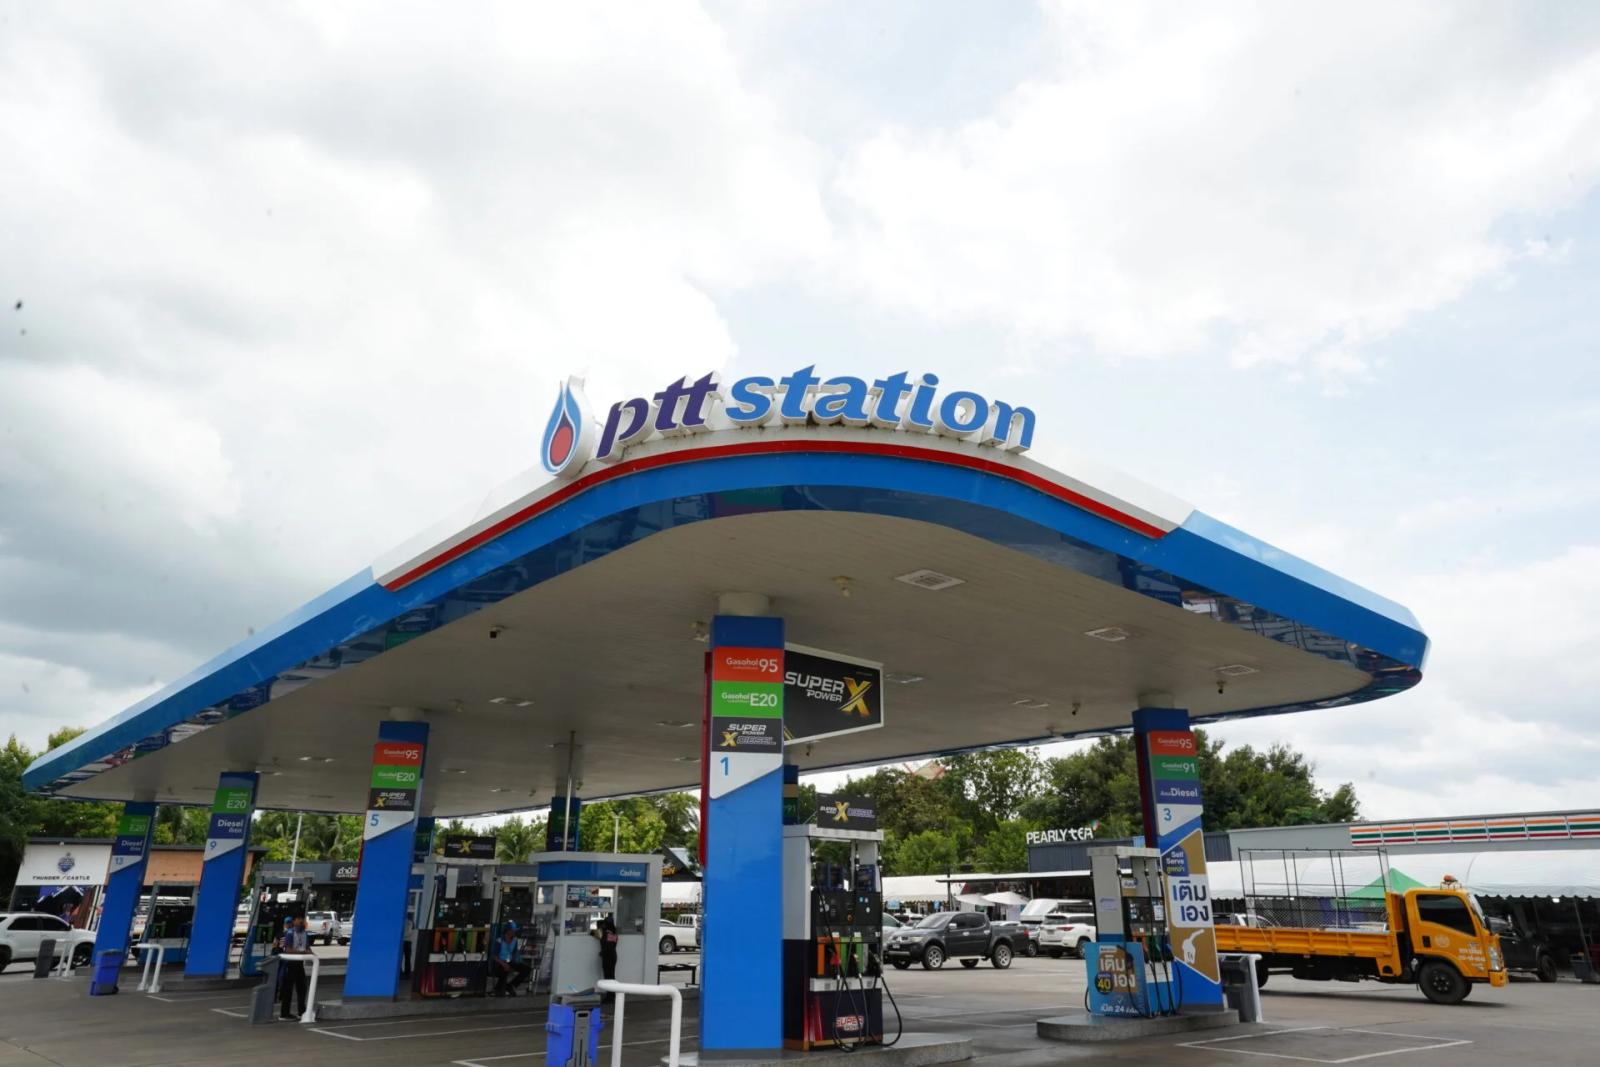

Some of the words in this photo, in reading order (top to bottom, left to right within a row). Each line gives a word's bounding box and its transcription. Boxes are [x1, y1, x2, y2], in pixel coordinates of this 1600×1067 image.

[596, 371, 718, 460] ptt
[725, 364, 1037, 450] station
[726, 658, 758, 666] Gasohol
[759, 659, 778, 673] 95
[784, 671, 845, 694] SUPER
[721, 692, 750, 700] Gasohol
[750, 693, 778, 707] E20
[806, 689, 842, 702] POWER
[727, 723, 767, 731] SUPER
[1179, 739, 1193, 749] 95
[405, 750, 419, 760] 95
[720, 757, 730, 776] 1
[1182, 762, 1196, 773] 91
[396, 772, 415, 781] E20
[1170, 787, 1198, 797] Diesel
[226, 799, 247, 809] E20
[370, 814, 380, 827] 5
[1163, 807, 1172, 821] 3
[217, 819, 244, 827] Diesel
[1025, 828, 1068, 844] PEARLY
[210, 841, 217, 850] 9
[1172, 880, 1207, 901] เติม
[1180, 905, 1209, 922] เอง
[1098, 978, 1111, 989] 40
